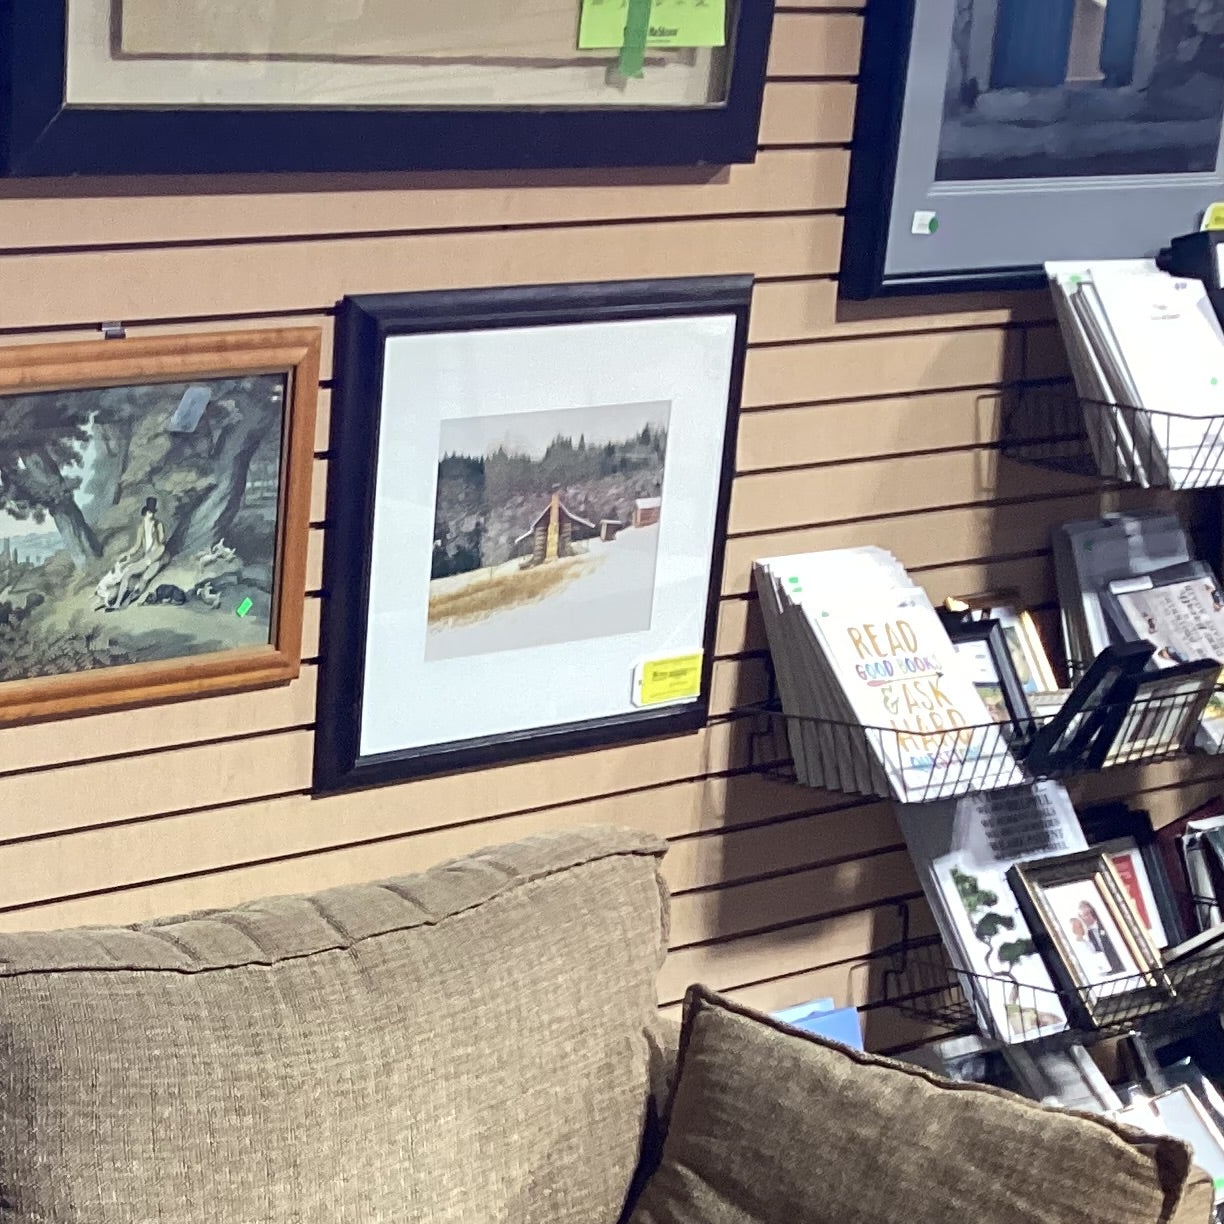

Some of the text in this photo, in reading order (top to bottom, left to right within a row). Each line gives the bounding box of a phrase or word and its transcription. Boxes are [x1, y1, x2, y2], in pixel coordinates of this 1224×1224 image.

[847, 620, 918, 660] READ
[855, 655, 943, 681] GOOD BOOKS
[902, 678, 954, 715] ASK
[890, 709, 972, 753] HARD
